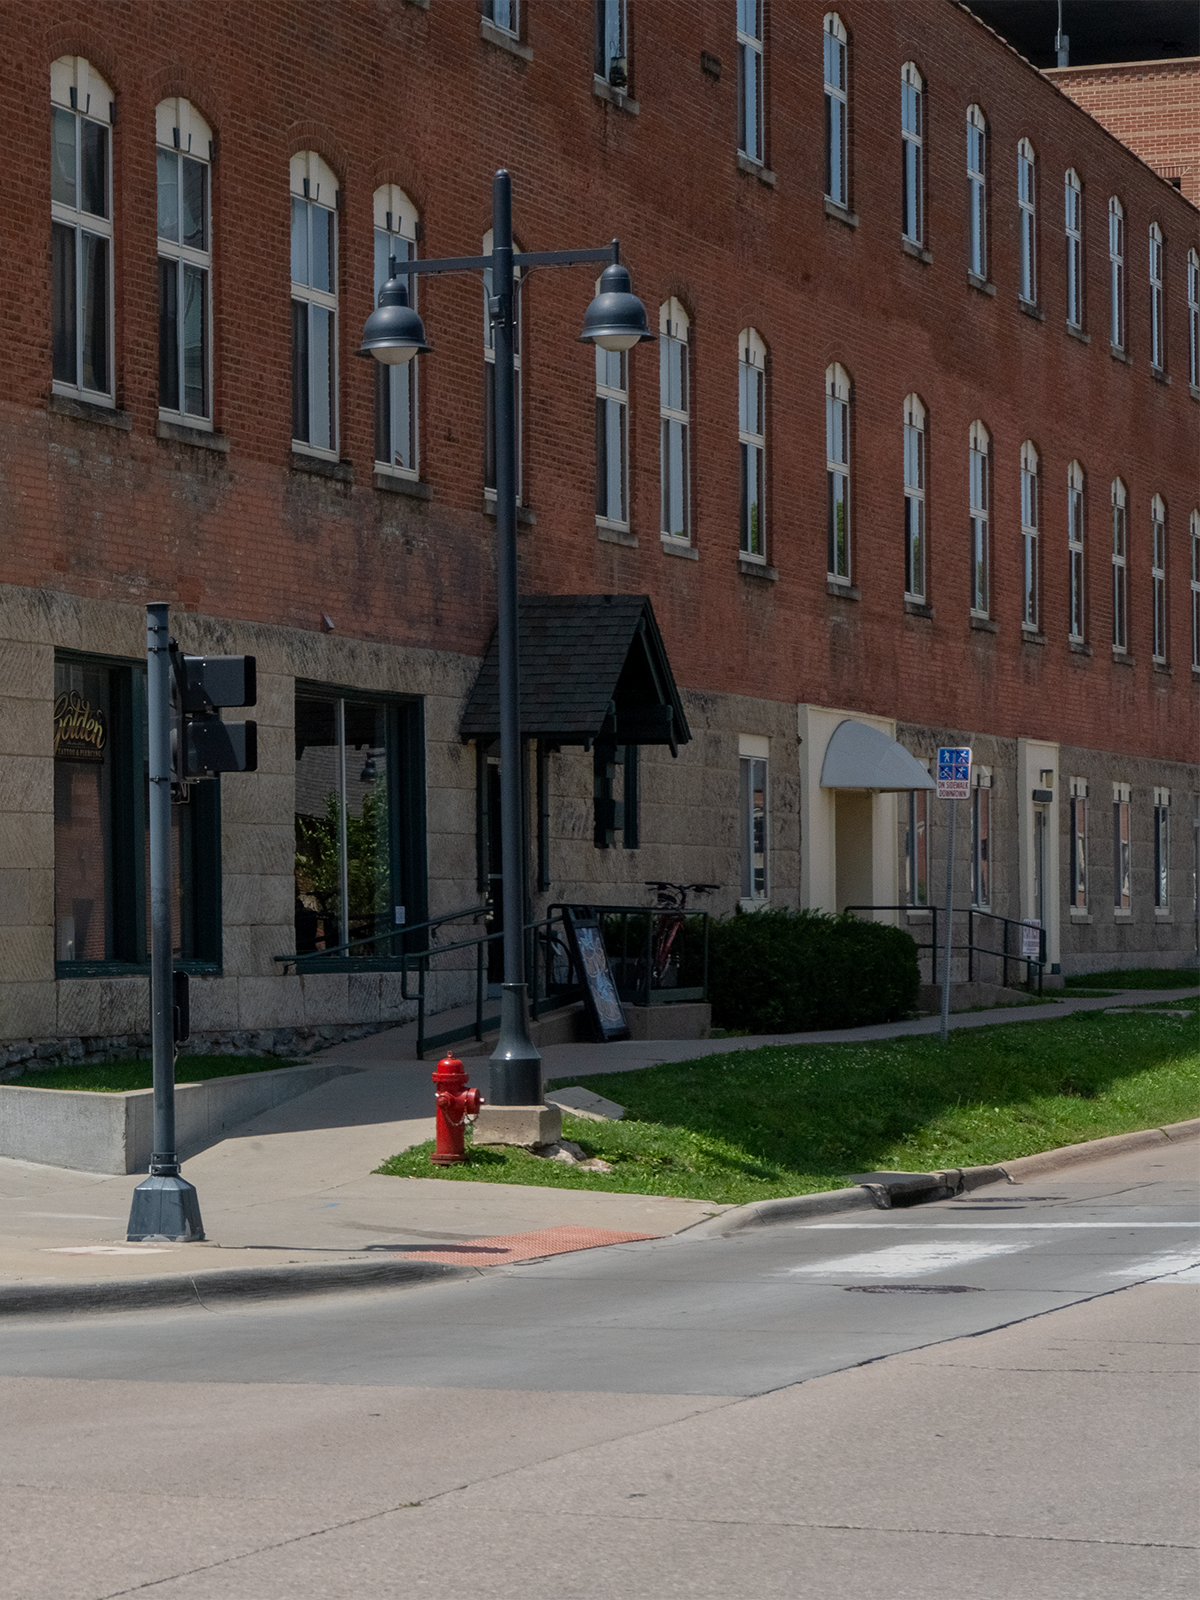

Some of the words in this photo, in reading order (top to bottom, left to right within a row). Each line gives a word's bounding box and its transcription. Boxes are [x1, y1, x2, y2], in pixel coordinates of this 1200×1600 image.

[54, 689, 106, 758] Golden
[57, 748, 76, 756] TATTOO
[80, 749, 102, 758] PIERCING
[938, 781, 945, 789] ON
[946, 781, 969, 789] SIDEWALK
